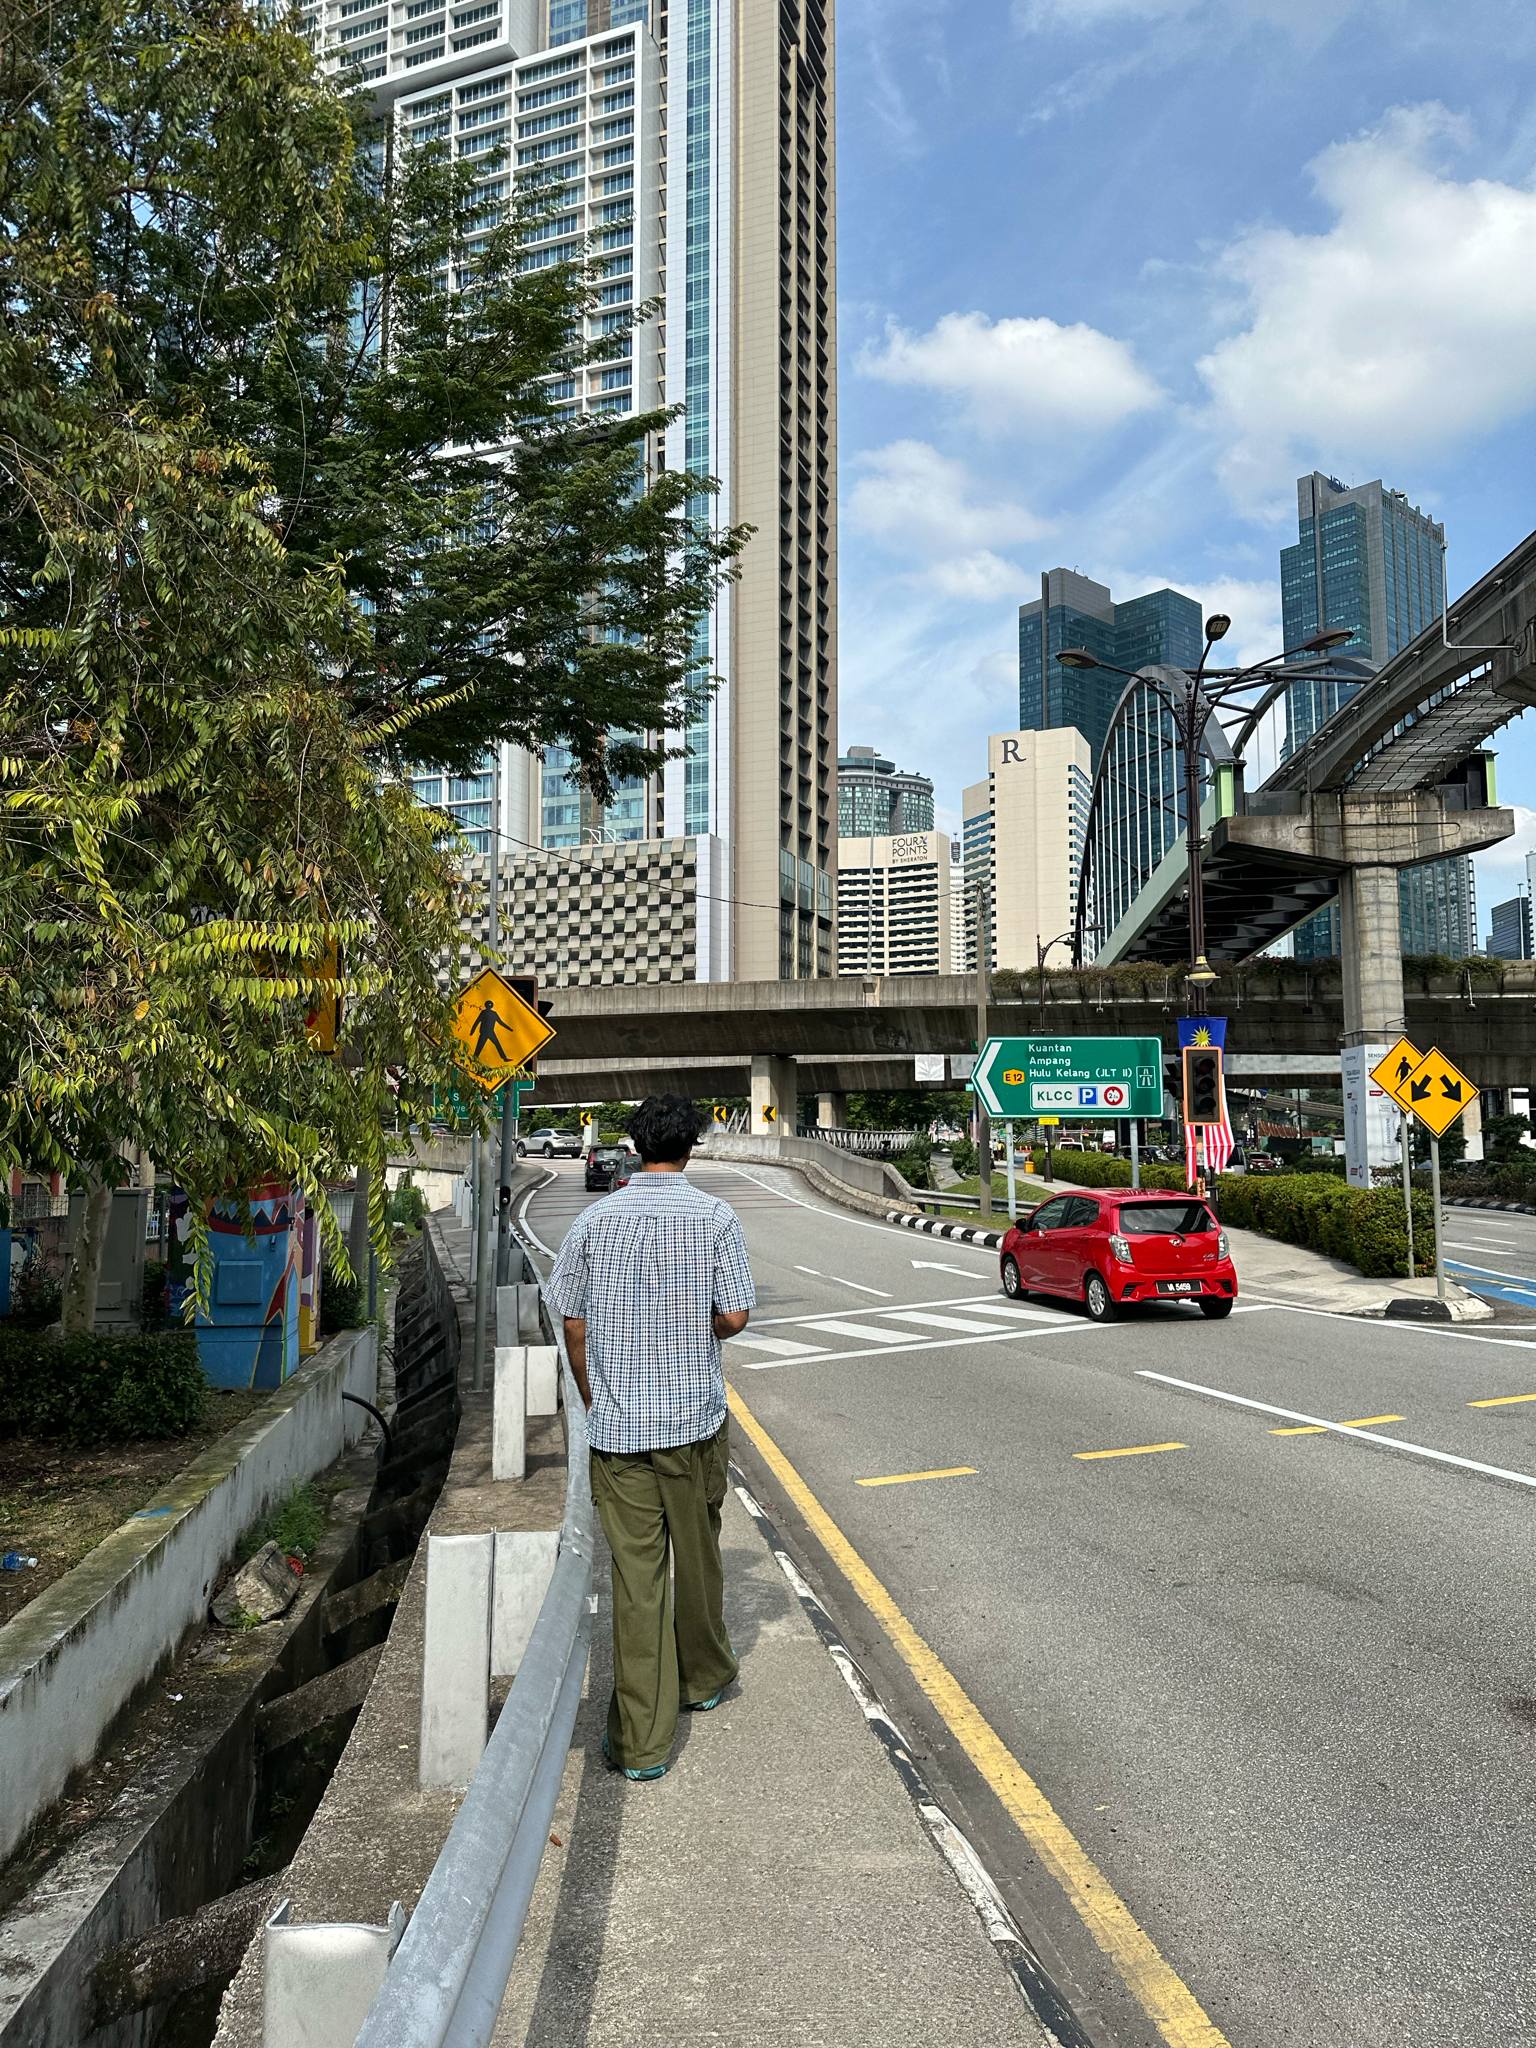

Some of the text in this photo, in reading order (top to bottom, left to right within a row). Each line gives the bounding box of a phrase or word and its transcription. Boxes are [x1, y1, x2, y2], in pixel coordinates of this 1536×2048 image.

[1001, 739, 1027, 764] R
[892, 836, 919, 848] FOUR
[892, 844, 928, 857] POINTS
[900, 855, 928, 864] SHERATON
[1028, 1043, 1072, 1053] Kuantan
[1029, 1056, 1071, 1067] Ampang
[1005, 1073, 1023, 1082] E 12
[1029, 1068, 1051, 1078] Hulu
[1056, 1068, 1090, 1079] Kelang
[1095, 1067, 1117, 1078] (JLT
[1037, 1088, 1094, 1104] KLCC P
